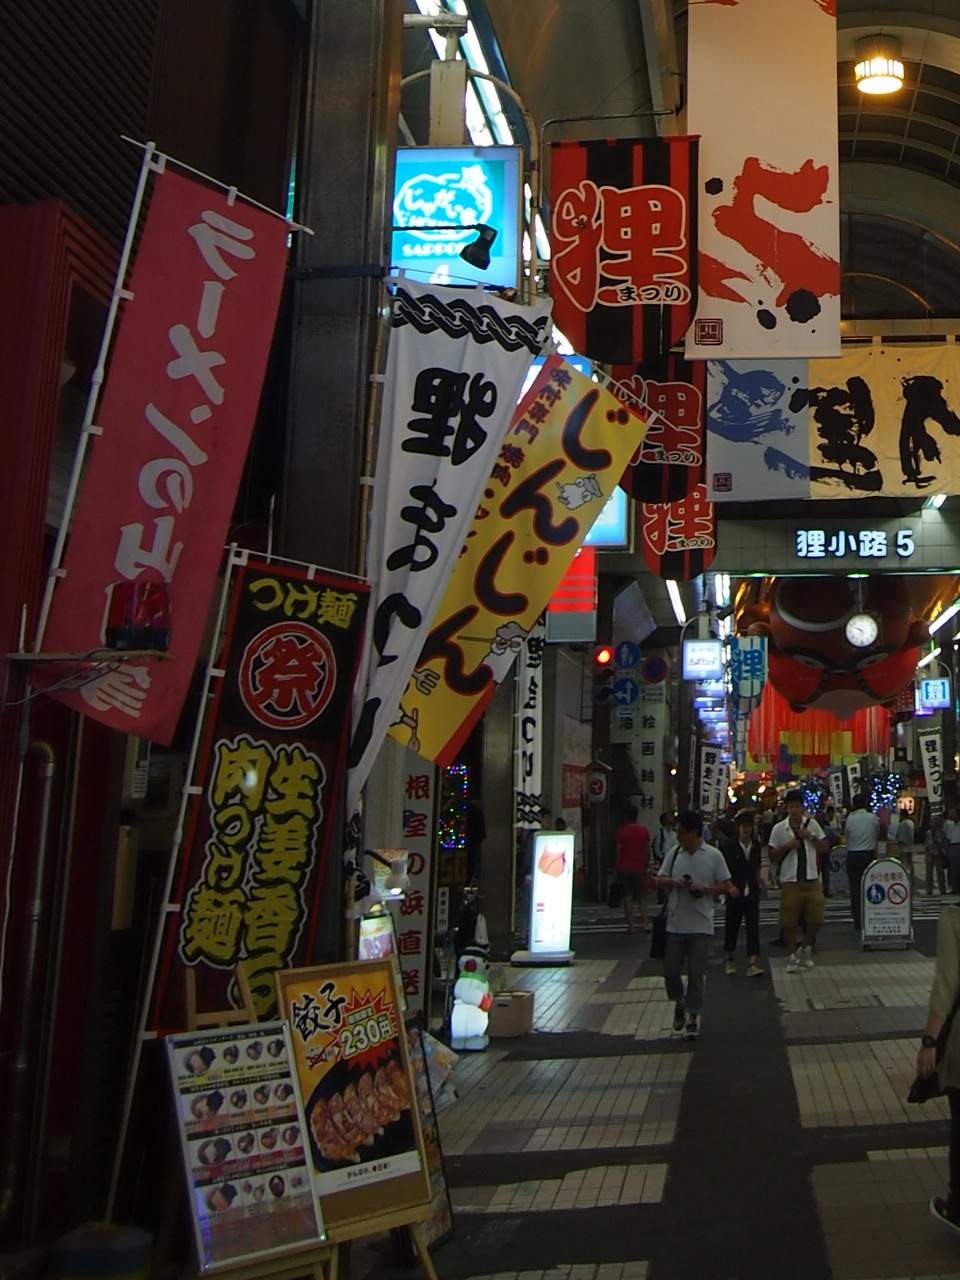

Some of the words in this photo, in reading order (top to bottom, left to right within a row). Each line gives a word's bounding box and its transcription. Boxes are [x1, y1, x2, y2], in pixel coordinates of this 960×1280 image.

[617, 284, 683, 304] まつり
[416, 388, 630, 697] じんじん
[796, 530, 888, 558] 狸小路
[896, 530, 915, 557] 5
[248, 577, 360, 630] つけ麺
[249, 629, 328, 720] 祭
[925, 739, 943, 797] 狸まつり
[182, 737, 274, 965] 肉つけ麺
[291, 981, 347, 1044] 餃子
[340, 1012, 395, 1060] 230円
